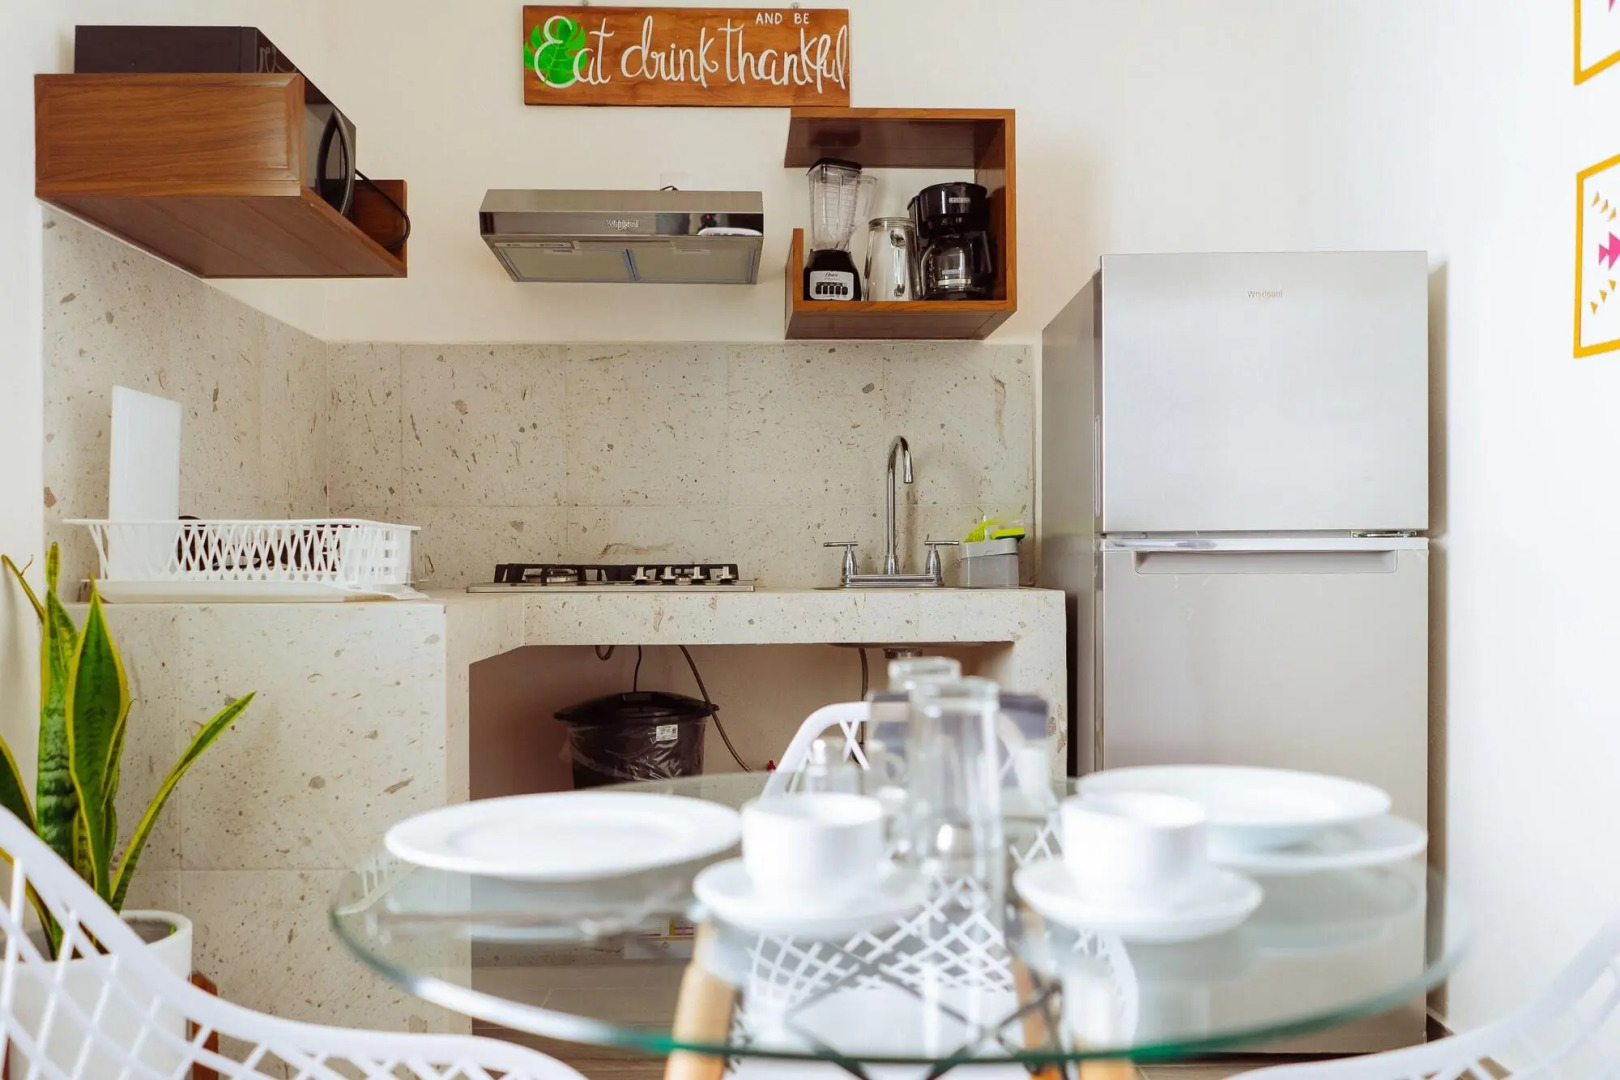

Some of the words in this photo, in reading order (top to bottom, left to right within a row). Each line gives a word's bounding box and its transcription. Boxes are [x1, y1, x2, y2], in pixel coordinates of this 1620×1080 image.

[755, 12, 783, 25] AND
[793, 12, 810, 25] BE
[534, 15, 615, 89] Eat
[620, 15, 719, 88] drink
[717, 18, 848, 94] thankful
